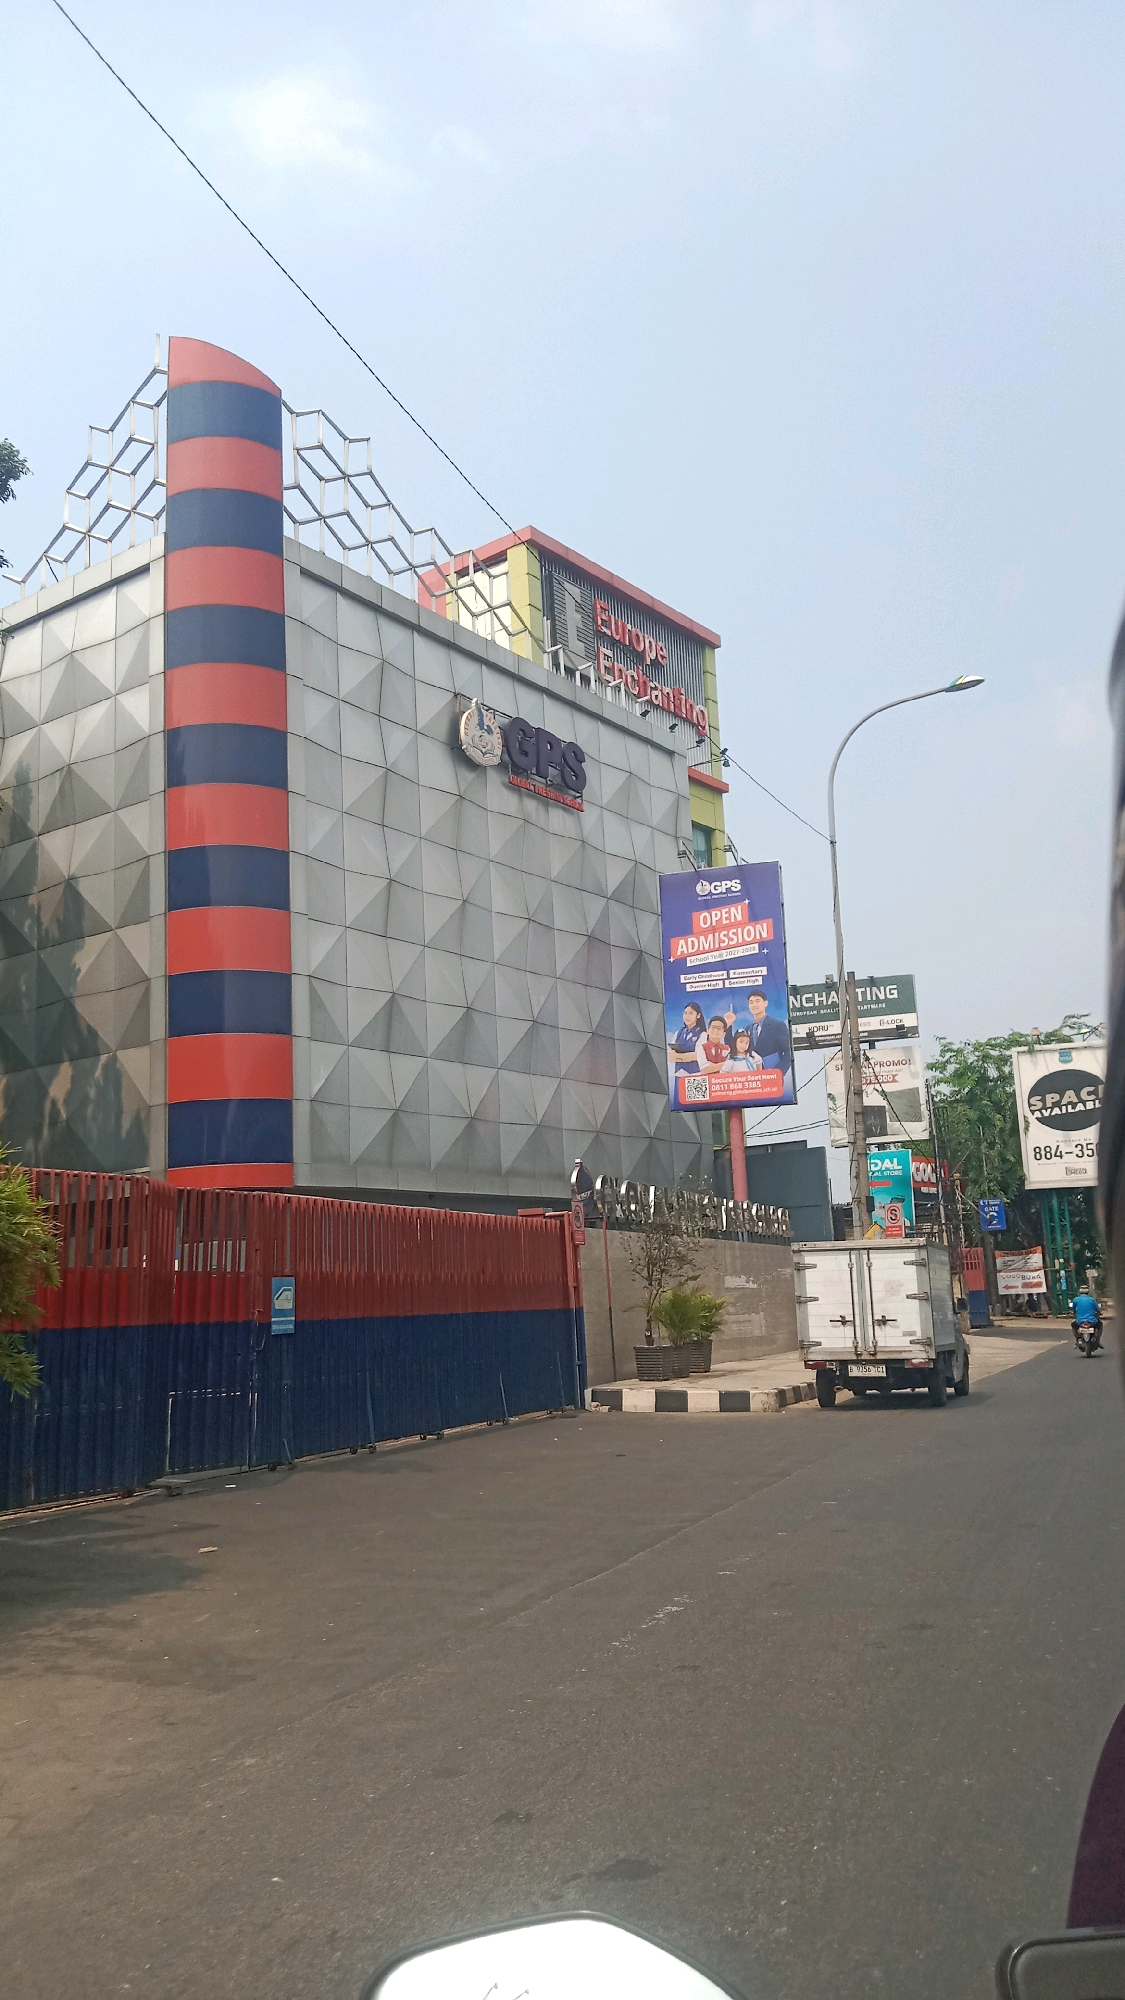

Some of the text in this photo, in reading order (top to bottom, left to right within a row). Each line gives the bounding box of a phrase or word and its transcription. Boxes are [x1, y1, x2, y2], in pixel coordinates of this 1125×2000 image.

[594, 598, 667, 666] Europe
[597, 646, 708, 736] Enchanting
[504, 716, 586, 792] GPS
[710, 879, 741, 893] GPS
[699, 905, 743, 929] OPEN
[676, 922, 768, 956] ADMISSION
[689, 955, 709, 965] School
[711, 952, 724, 960] Year
[790, 984, 898, 1009] NCHATING
[835, 1058, 912, 1071] SPAL PROMO!
[1033, 1142, 1098, 1161] 884-35
[867, 1157, 903, 1171] DAL
